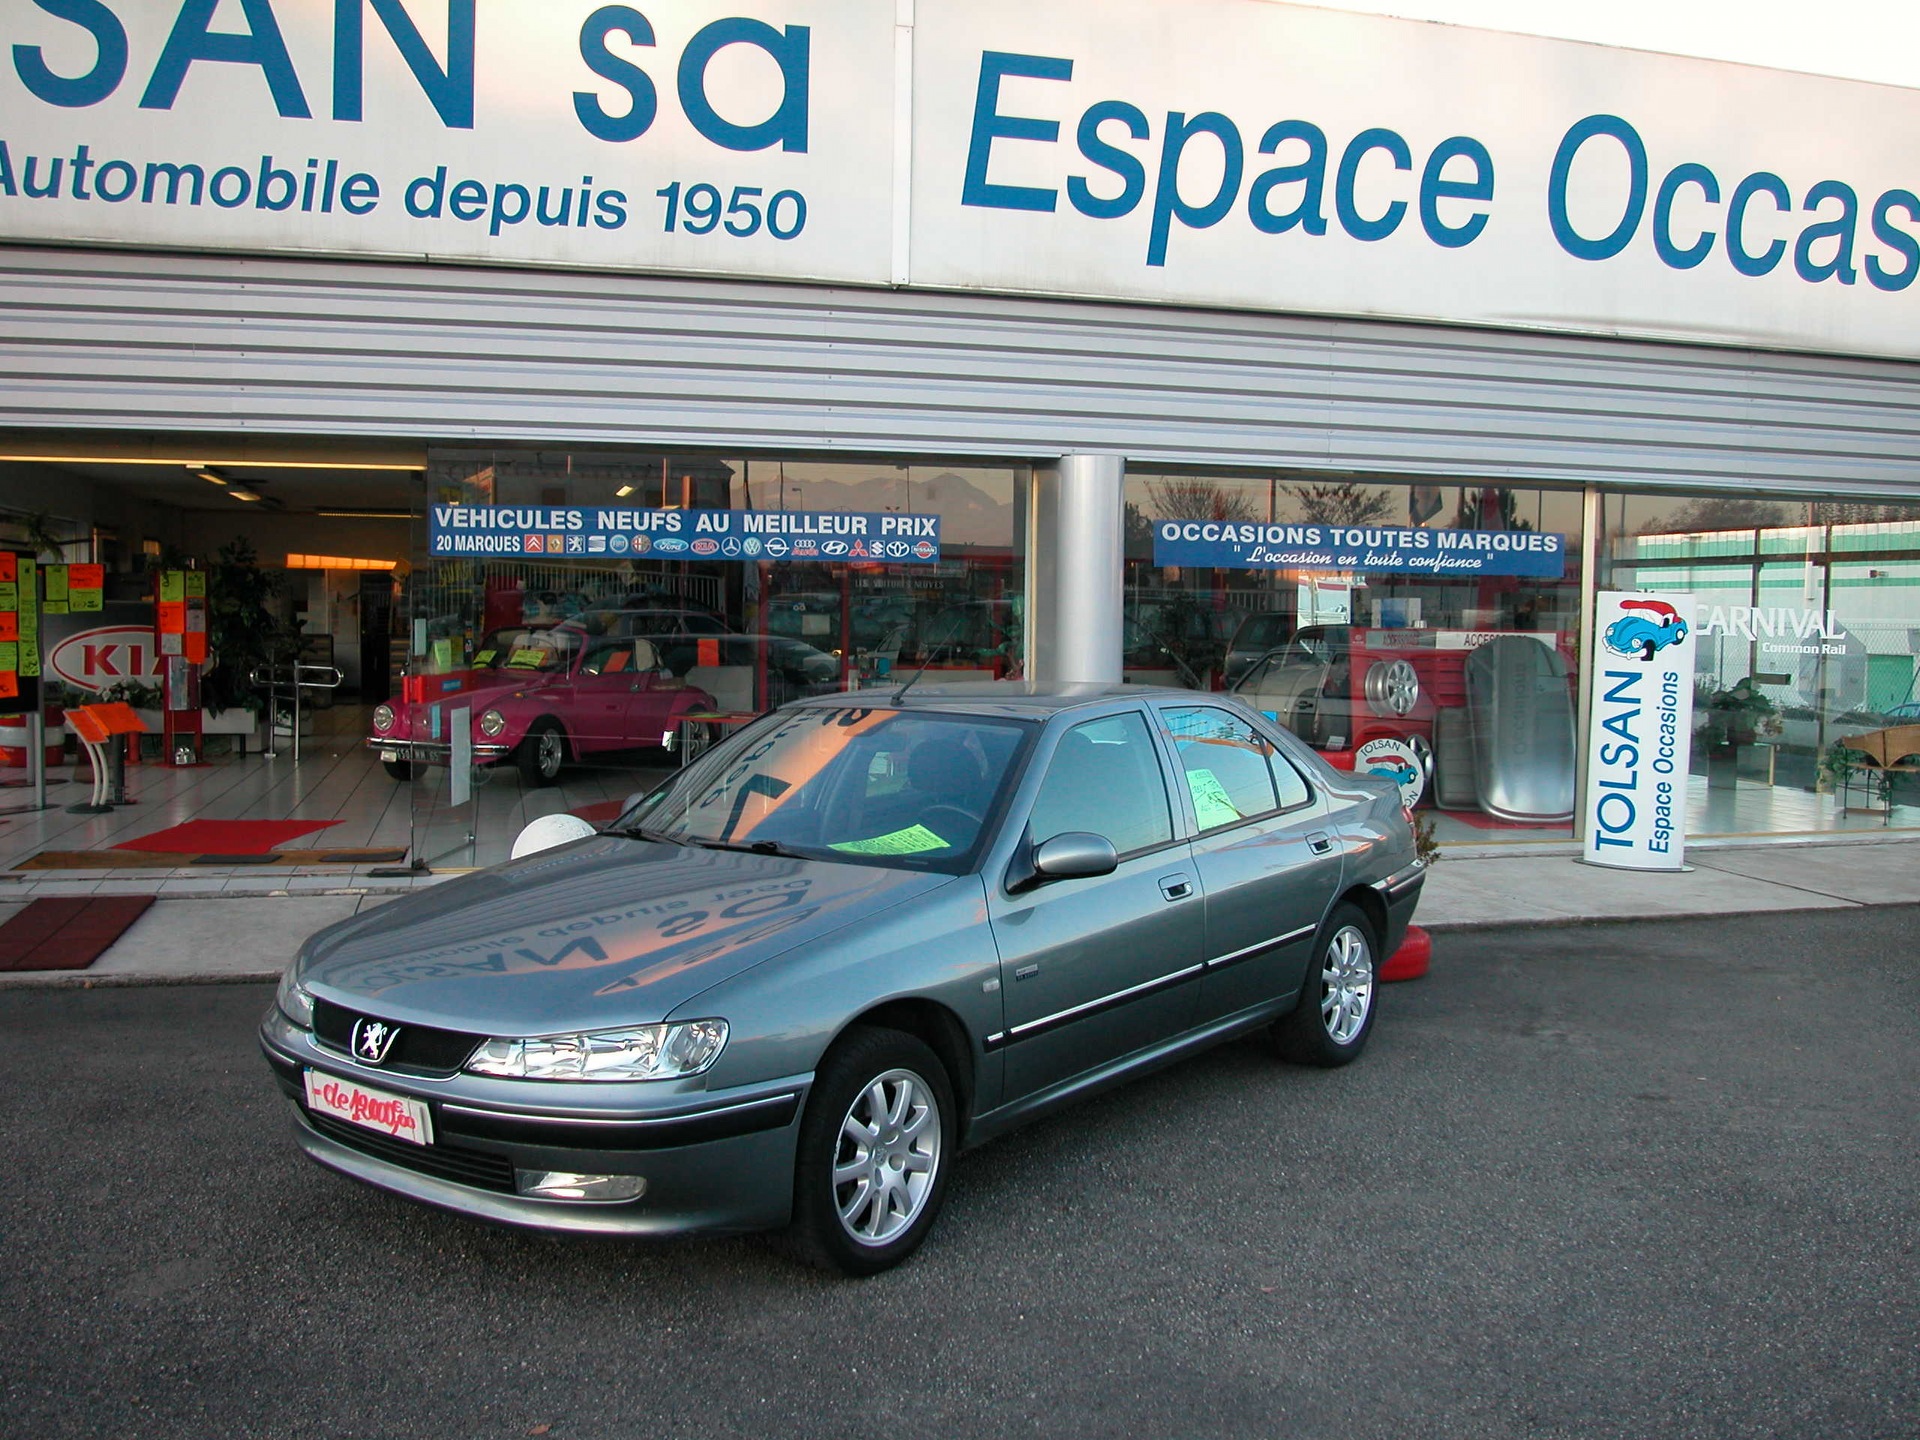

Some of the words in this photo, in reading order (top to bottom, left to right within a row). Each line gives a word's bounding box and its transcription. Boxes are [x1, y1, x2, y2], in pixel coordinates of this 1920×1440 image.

[15, 0, 474, 129] SAN
[573, 5, 810, 154] sa
[958, 48, 1494, 267] Espace
[1548, 114, 1920, 292] Occas
[404, 166, 627, 236] depuis
[656, 182, 807, 241] 1950
[435, 507, 584, 530] VEHICULES
[597, 510, 682, 532] NEUFS
[696, 513, 730, 533] AU
[743, 513, 868, 535] MEILLEUR
[881, 516, 937, 537] PRIX
[1161, 522, 1321, 545] OCCASIONS
[1330, 528, 1430, 548] TOUTES
[1437, 532, 1559, 553] MARQUES
[436, 534, 452, 551] 20
[455, 534, 521, 552] MARQUES
[1337, 555, 1359, 565] en
[1363, 550, 1403, 567] toute
[1408, 551, 1482, 572] confiance
[82, 644, 164, 676] KI
[1762, 642, 1819, 654] Common
[1821, 643, 1847, 655] Rail
[1652, 670, 1679, 775] Occasions
[1360, 739, 1401, 757] TOLSAN
[1594, 670, 1643, 851] TOLSAN
[1648, 780, 1675, 854] Espace
